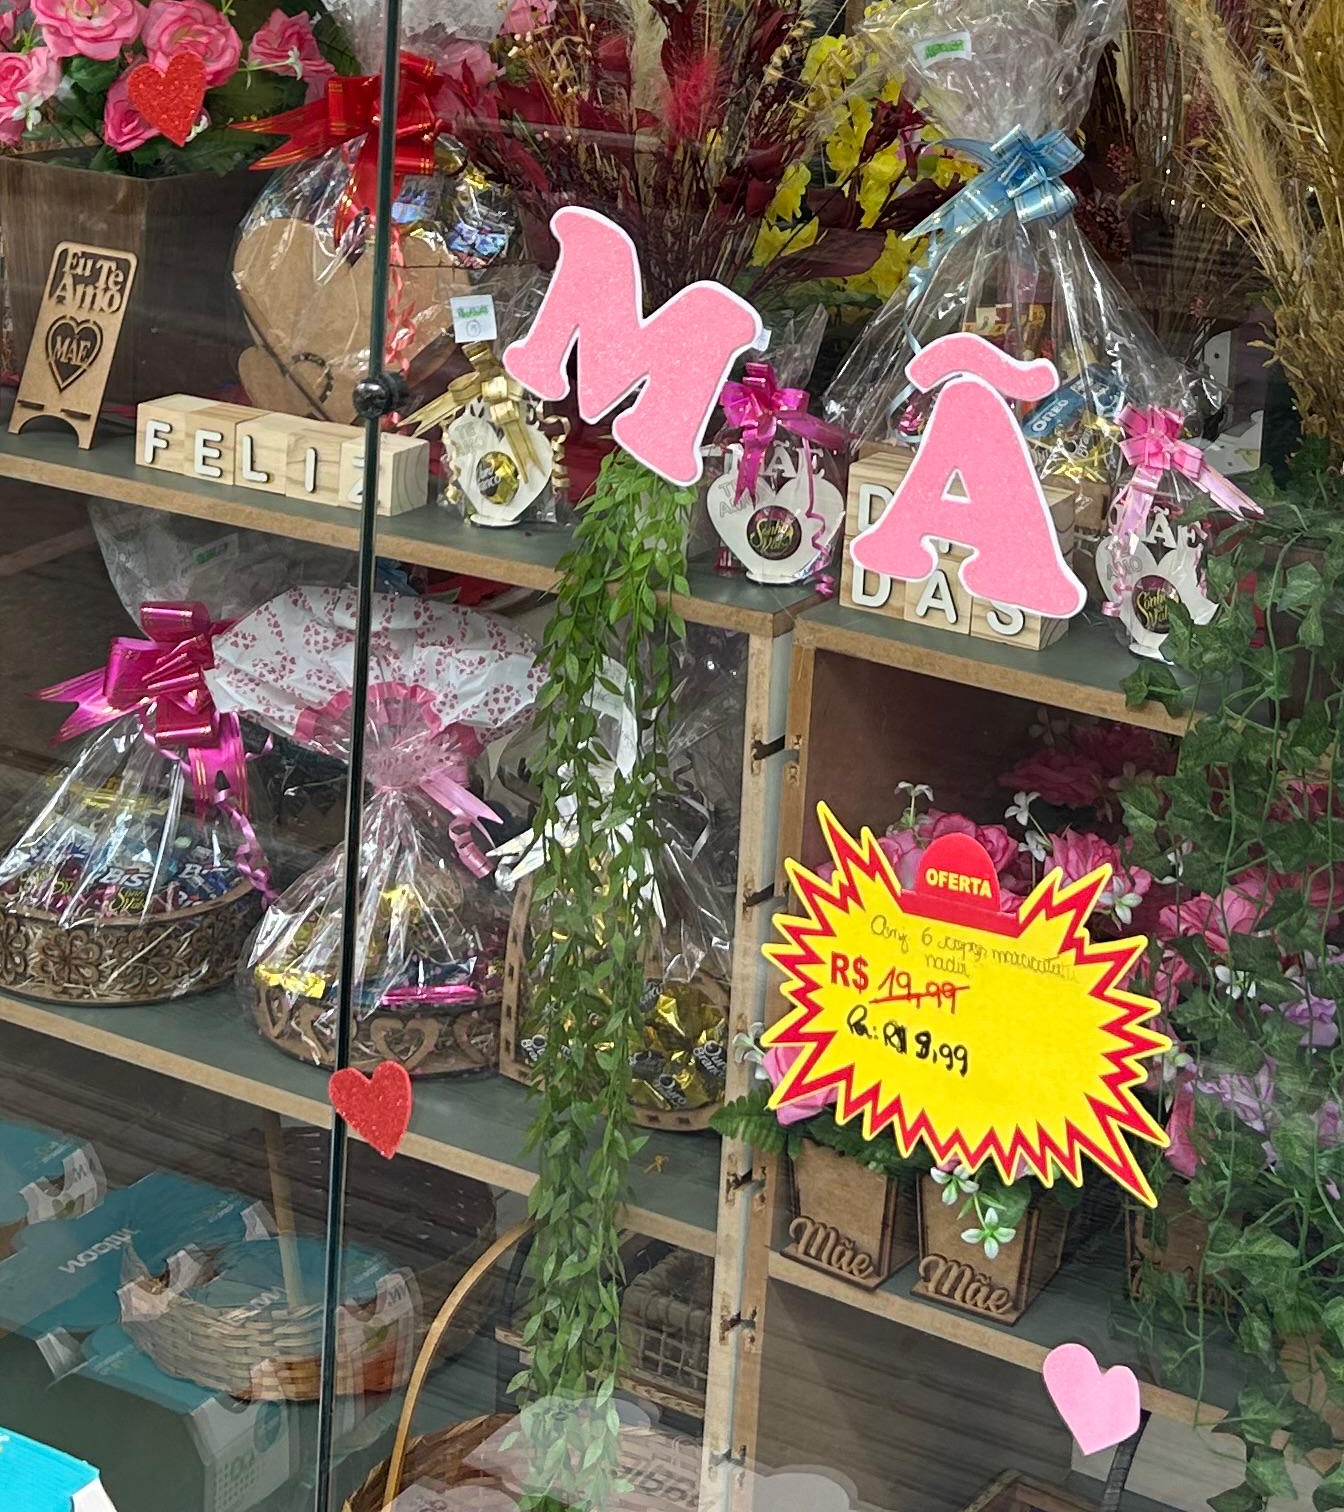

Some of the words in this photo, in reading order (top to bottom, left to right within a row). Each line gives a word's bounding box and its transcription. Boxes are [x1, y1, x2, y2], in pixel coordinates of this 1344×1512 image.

[56, 273, 123, 314] Amo
[62, 250, 93, 277] Eu
[96, 260, 124, 290] Te
[851, 563, 1027, 637] DAS
[924, 867, 993, 899] OFERTA
[921, 927, 933, 946] 6
[830, 950, 869, 995] R$
[869, 967, 971, 1015] 19,99
[788, 1215, 876, 1281] Mãe
[918, 1252, 1015, 1315] Mãe
